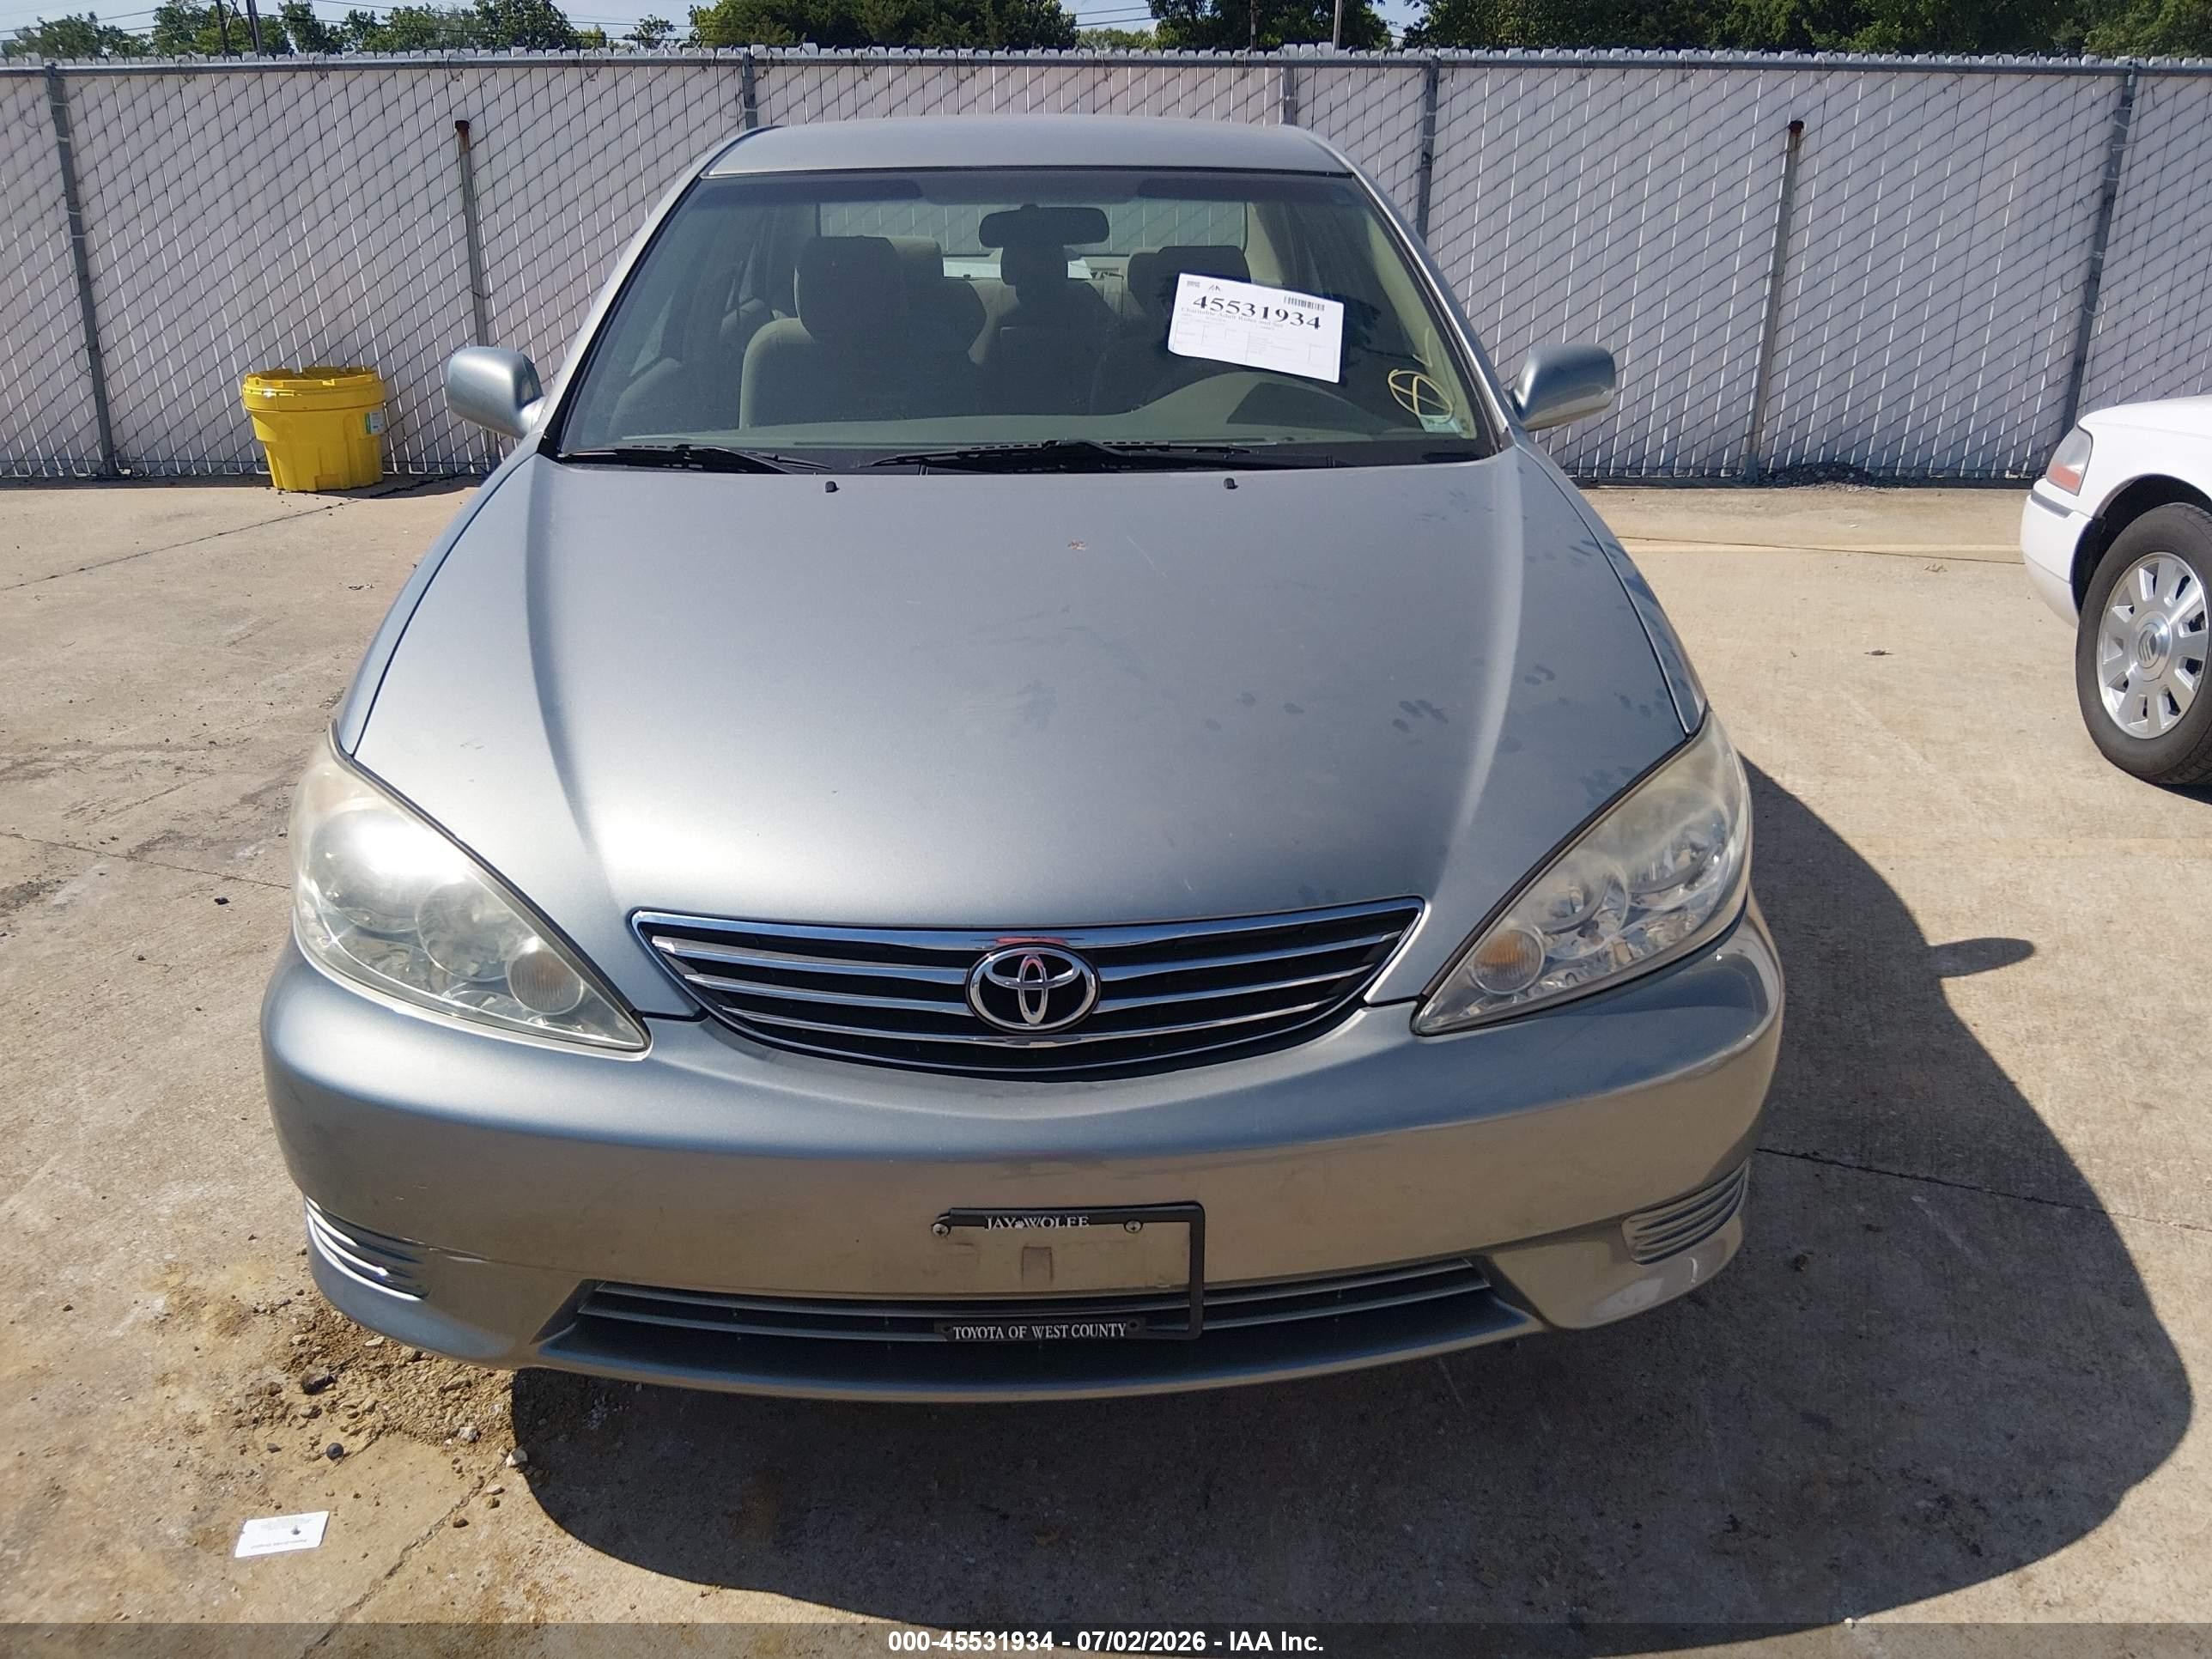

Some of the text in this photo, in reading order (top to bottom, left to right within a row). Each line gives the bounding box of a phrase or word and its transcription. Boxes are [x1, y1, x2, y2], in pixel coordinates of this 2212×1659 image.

[1193, 295, 1321, 330] 45531934
[985, 1216, 1090, 1231] JAY WOLFE
[953, 1322, 1127, 1340] TOYOTA OF WEST COUNTY
